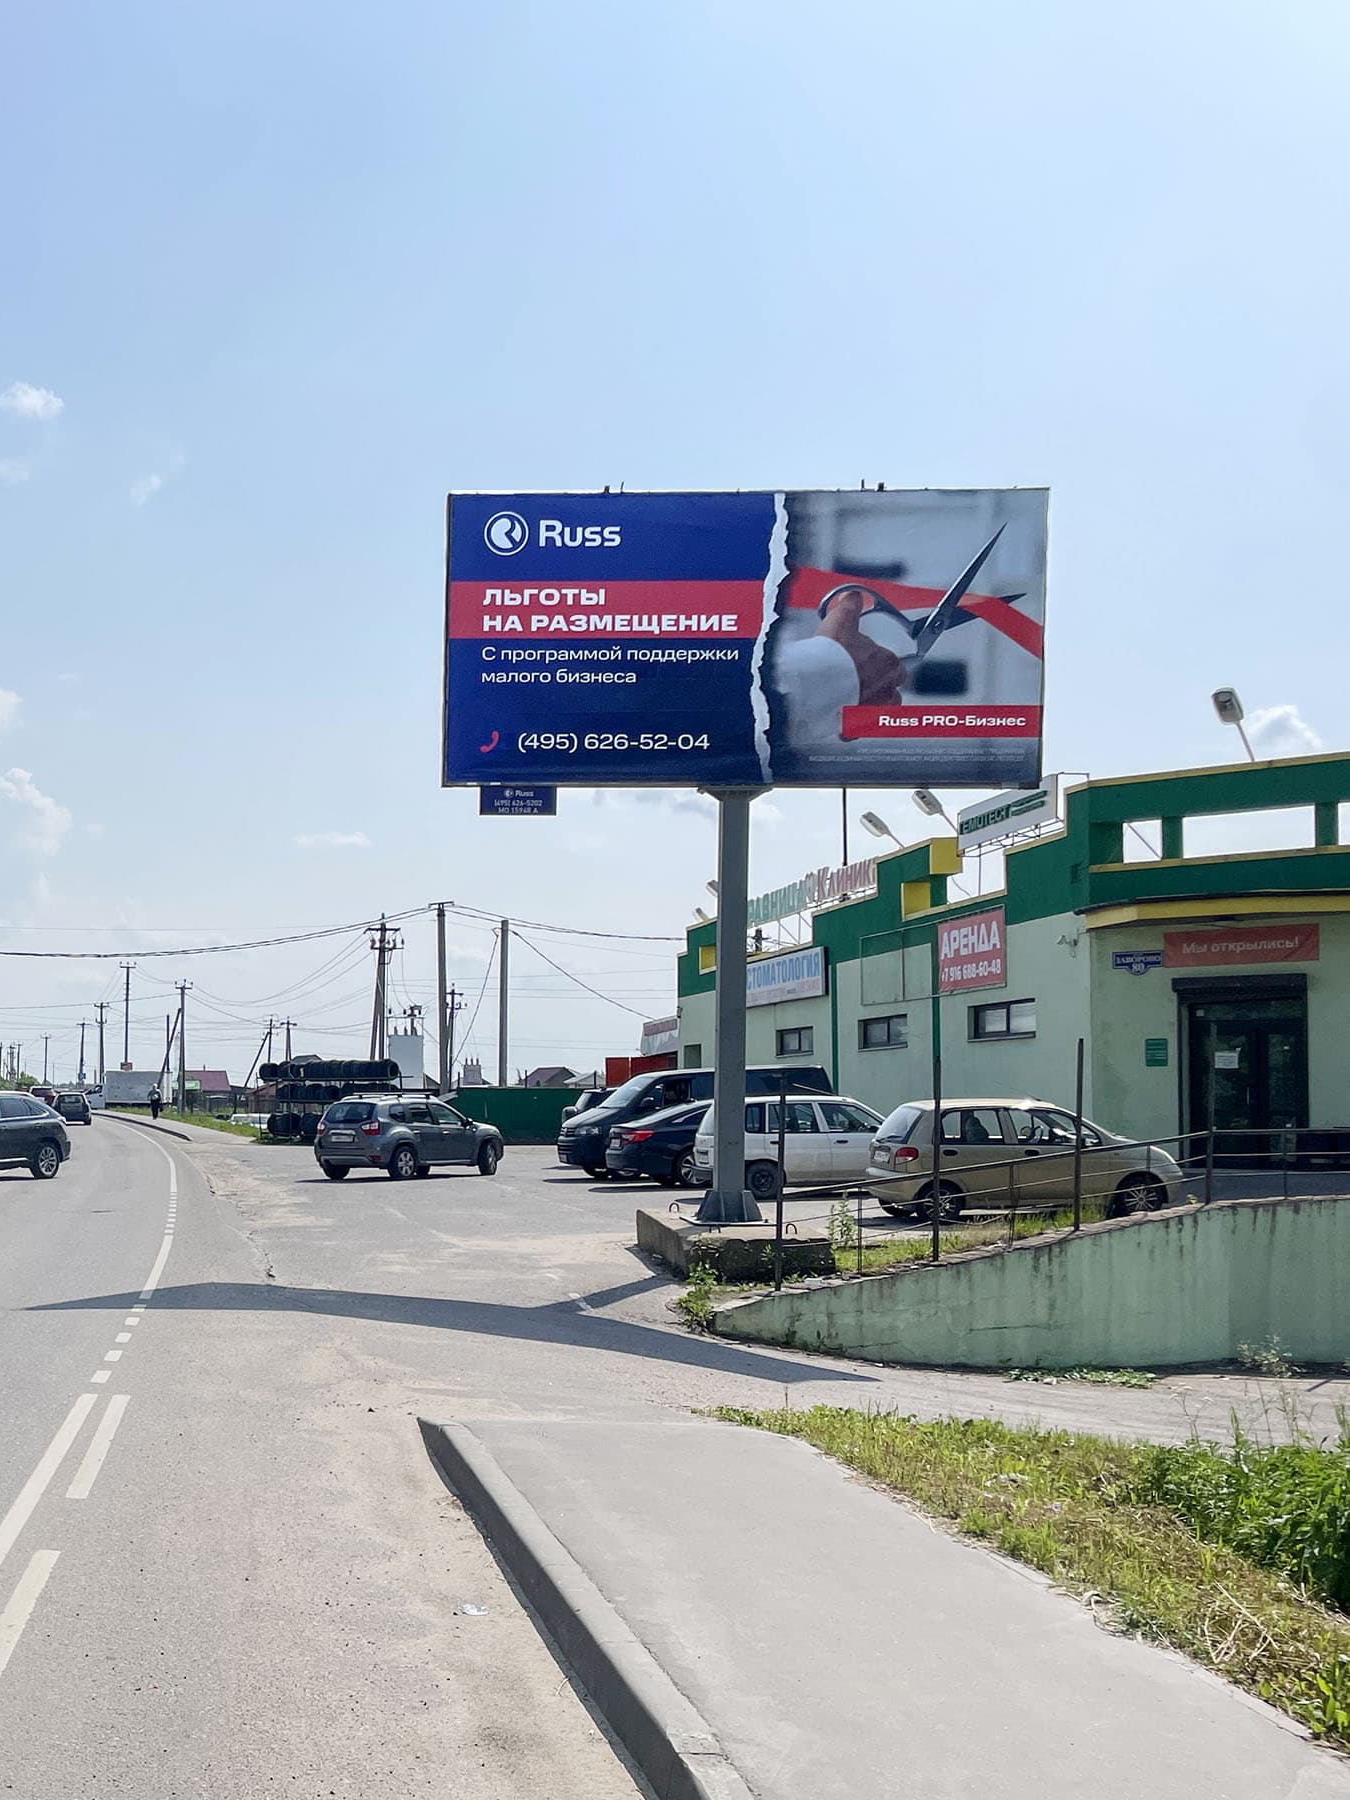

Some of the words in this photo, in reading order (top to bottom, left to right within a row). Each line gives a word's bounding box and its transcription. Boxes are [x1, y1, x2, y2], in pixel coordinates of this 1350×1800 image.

[538, 519, 622, 548] Russ
[482, 588, 606, 606] ЛЬГОТЫ
[482, 614, 524, 632] НА
[530, 614, 739, 635] РАЗМЕЩЕНИЕ
[481, 646, 497, 661] С
[500, 645, 622, 664] программой
[627, 649, 739, 664] поддержки
[481, 672, 551, 684] малого
[555, 668, 637, 684] бизнеса
[878, 715, 919, 727] Russ
[921, 715, 1027, 728] PRO-Бизнес
[517, 732, 578, 753] (495)
[583, 733, 710, 751] 626-52-04
[817, 858, 876, 900] КЛИНИК
[941, 920, 1001, 960] АРЕНДА
[1182, 943, 1208, 954] Мы
[1211, 936, 1300, 953] открылись!
[746, 952, 821, 990] СТОМАТОЛОГИЯ
